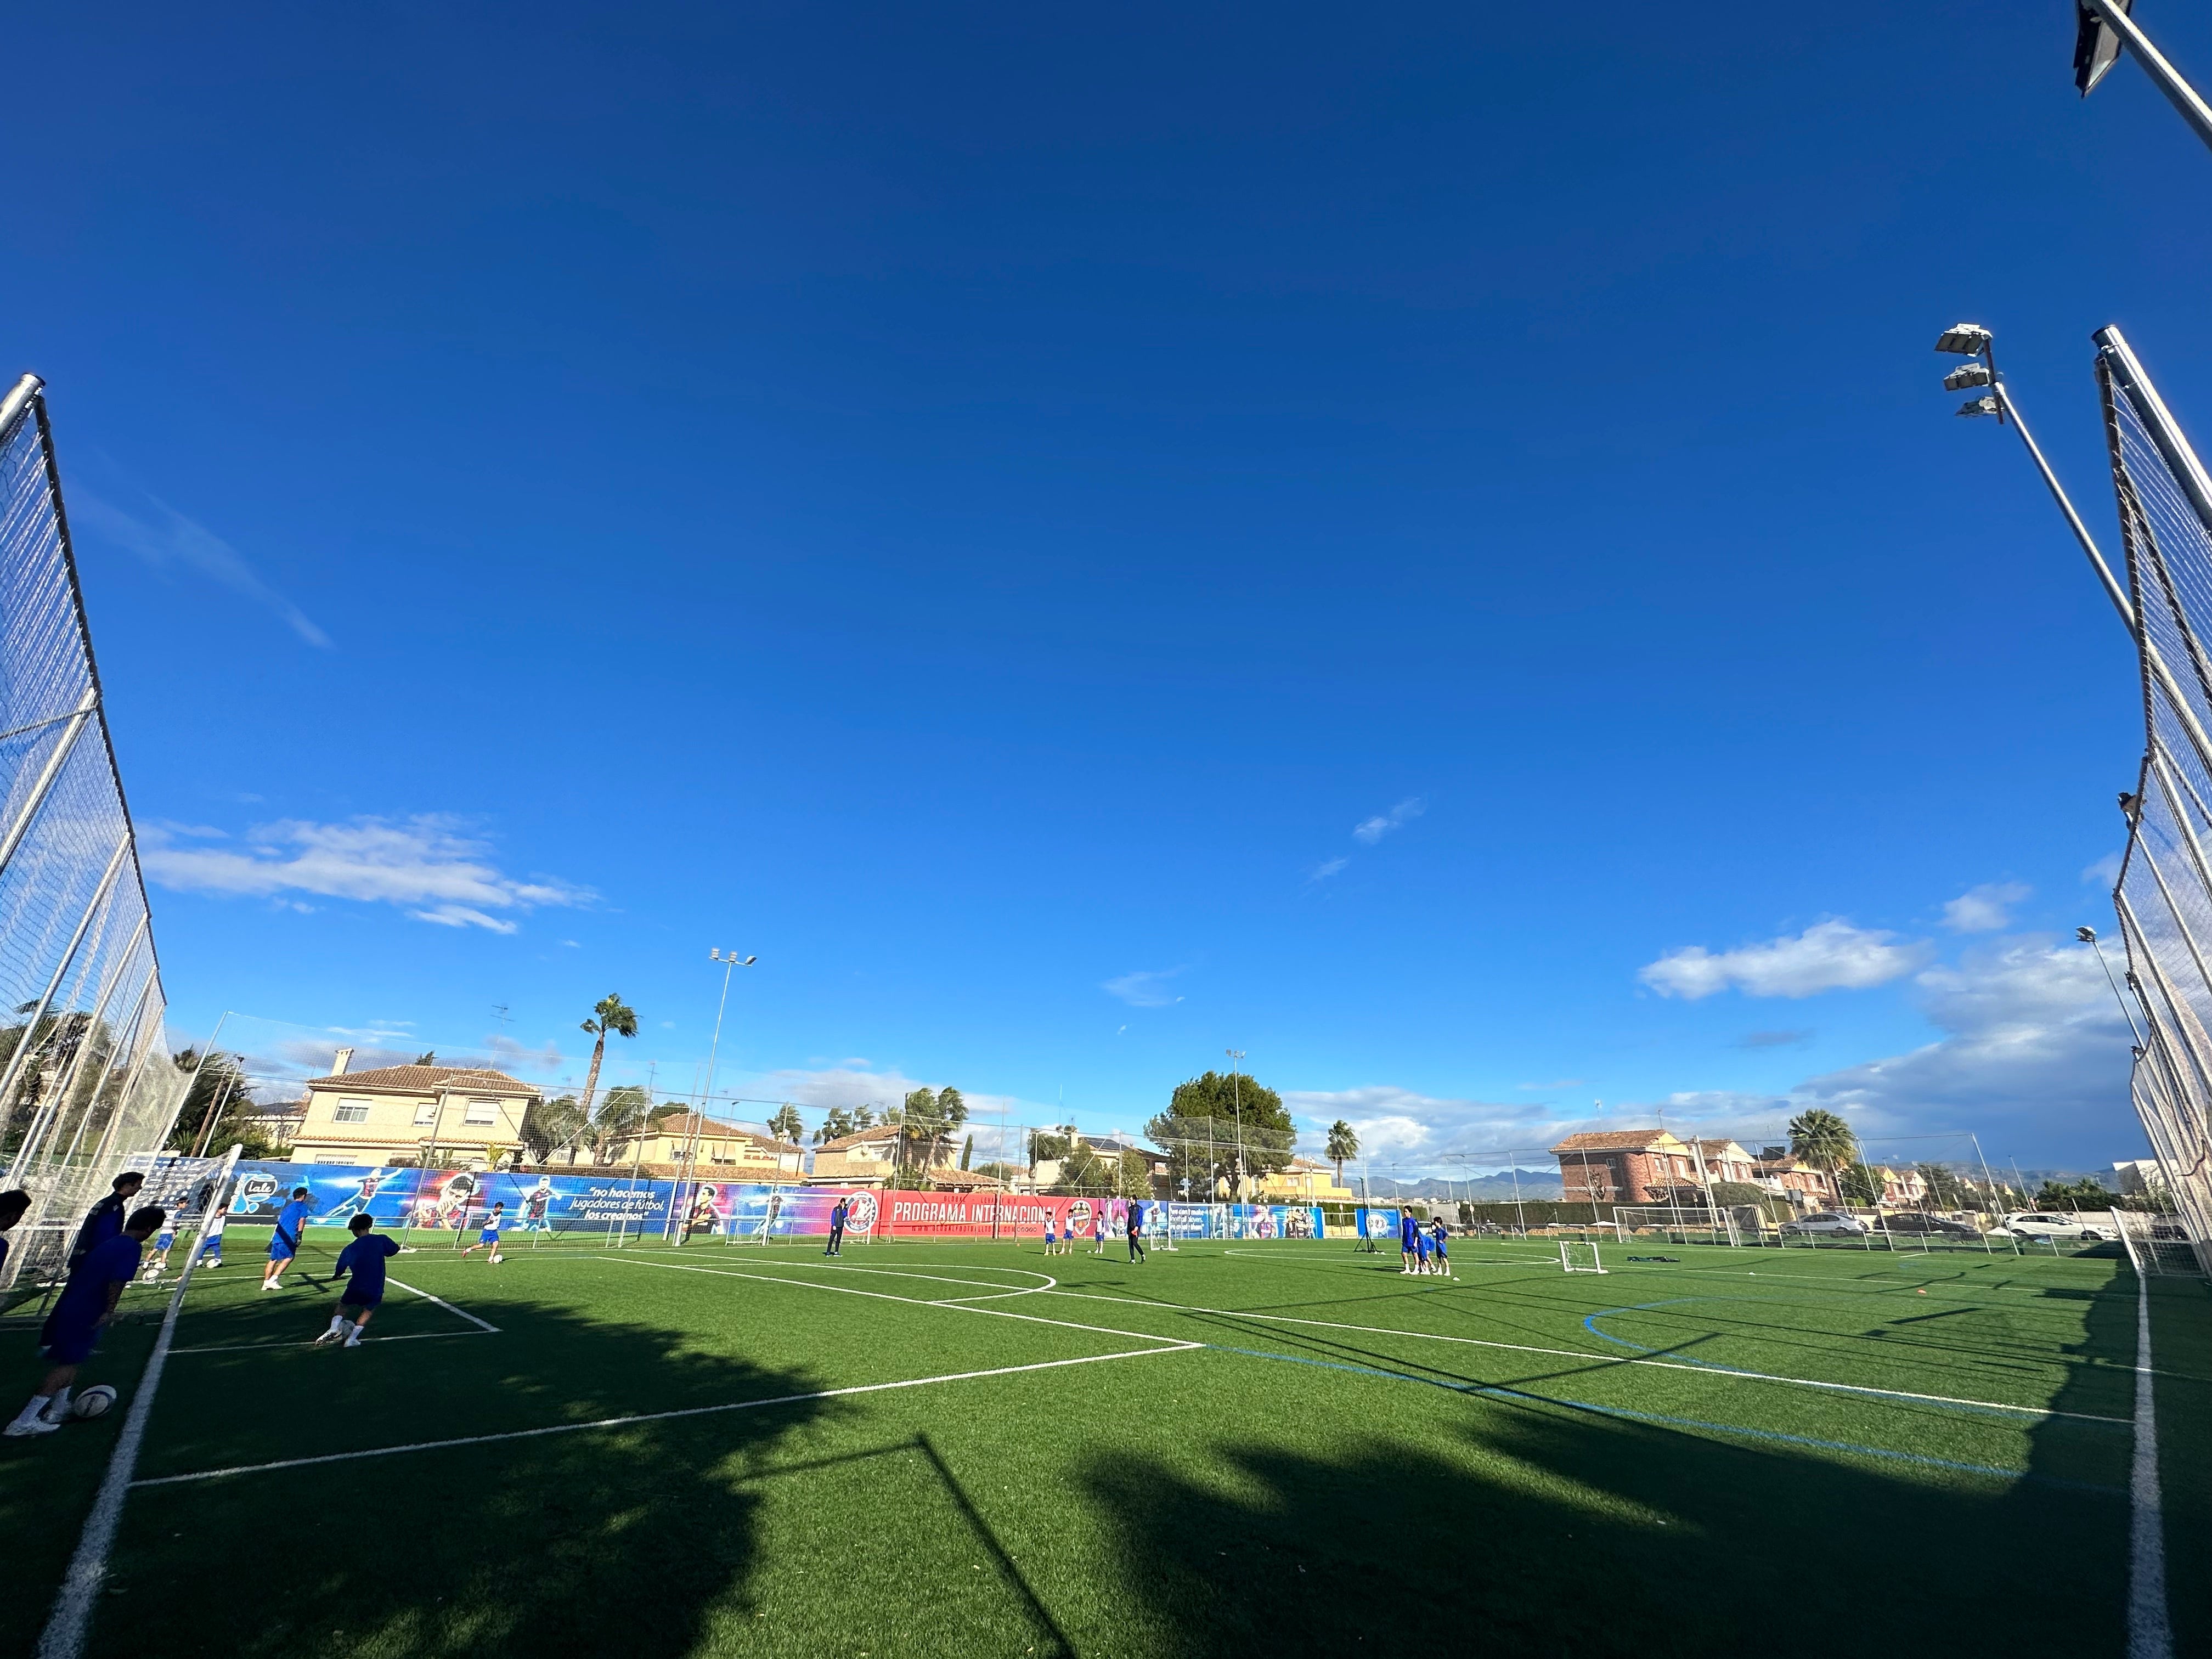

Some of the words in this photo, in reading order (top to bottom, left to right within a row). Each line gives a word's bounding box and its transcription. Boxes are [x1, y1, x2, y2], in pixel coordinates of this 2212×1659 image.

[608, 1187, 656, 1199] hacemos
[568, 1197, 621, 1210] jugadores
[584, 1209, 601, 1220] los
[893, 1201, 966, 1222] PROGRAMA
